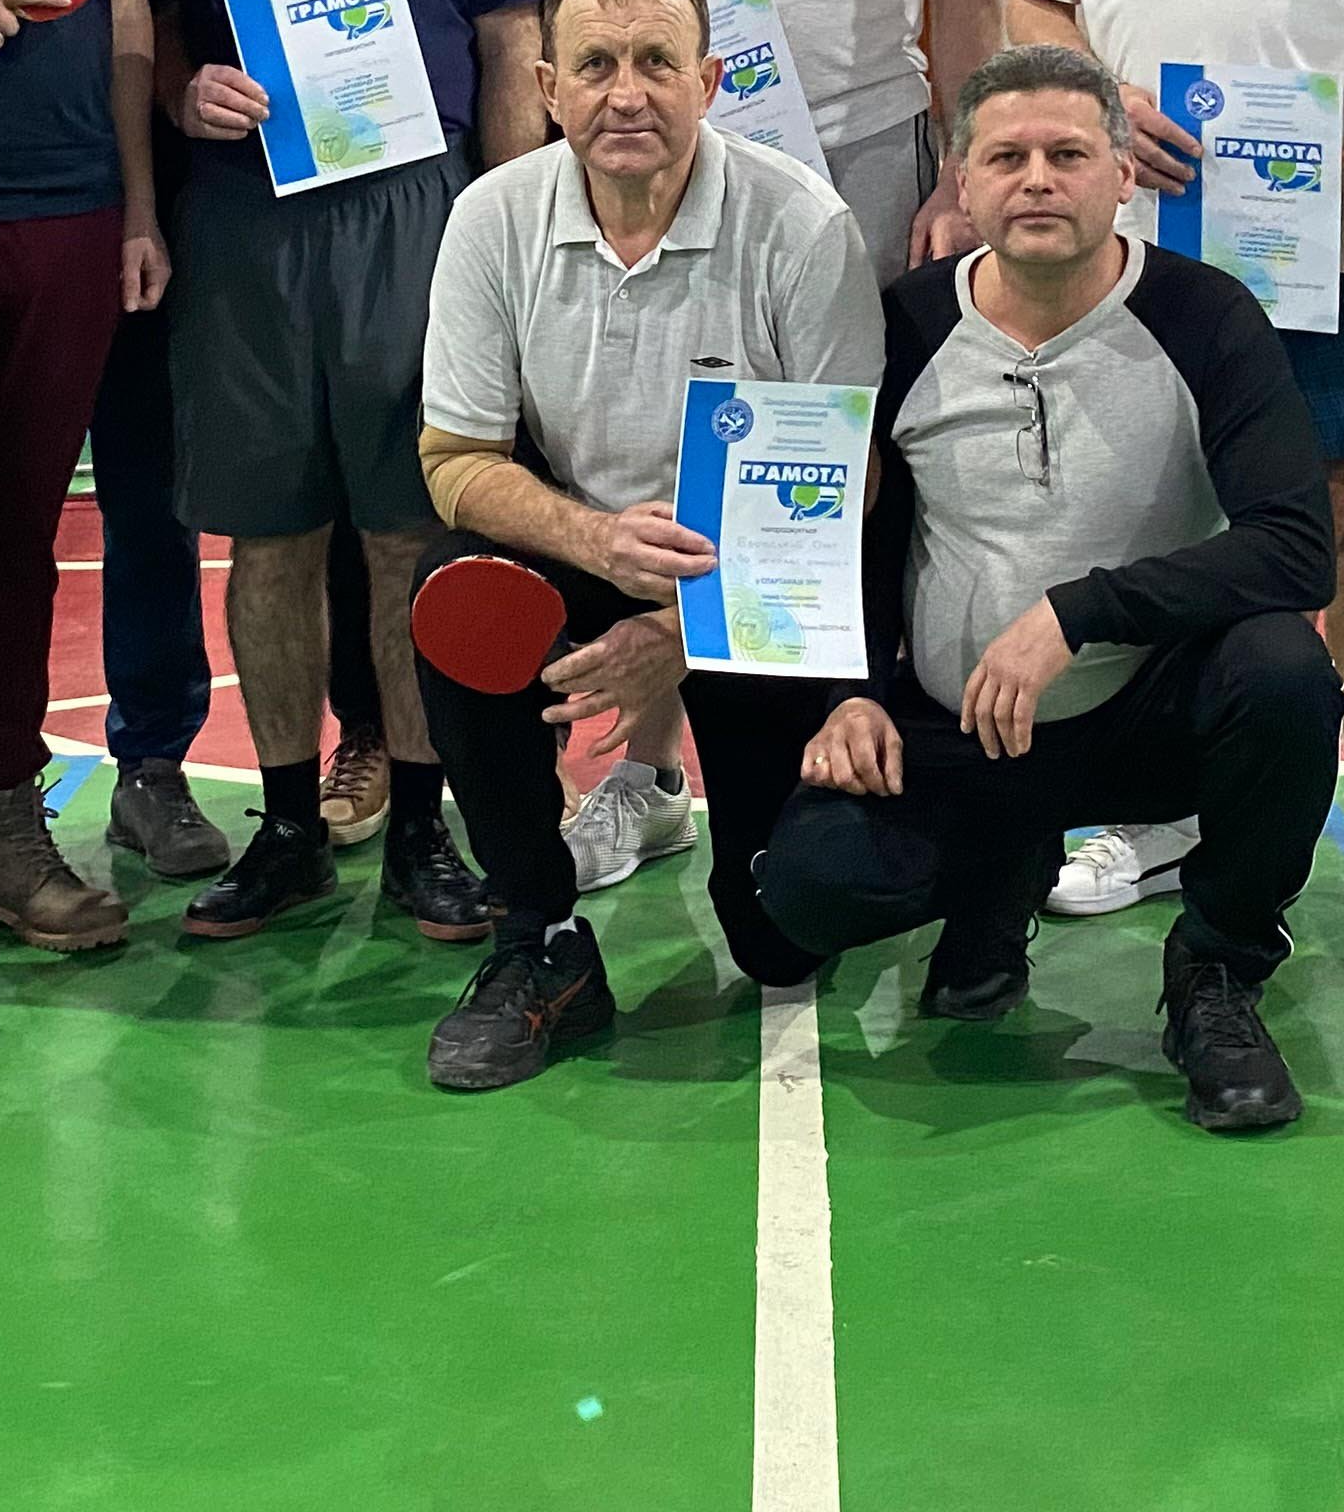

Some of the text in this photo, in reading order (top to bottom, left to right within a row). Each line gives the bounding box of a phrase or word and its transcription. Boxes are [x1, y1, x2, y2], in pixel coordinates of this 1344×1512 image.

[723, 46, 774, 74] МОТА
[1215, 140, 1321, 161] ГРАМОТА
[741, 464, 847, 485] ГРАМОТА
